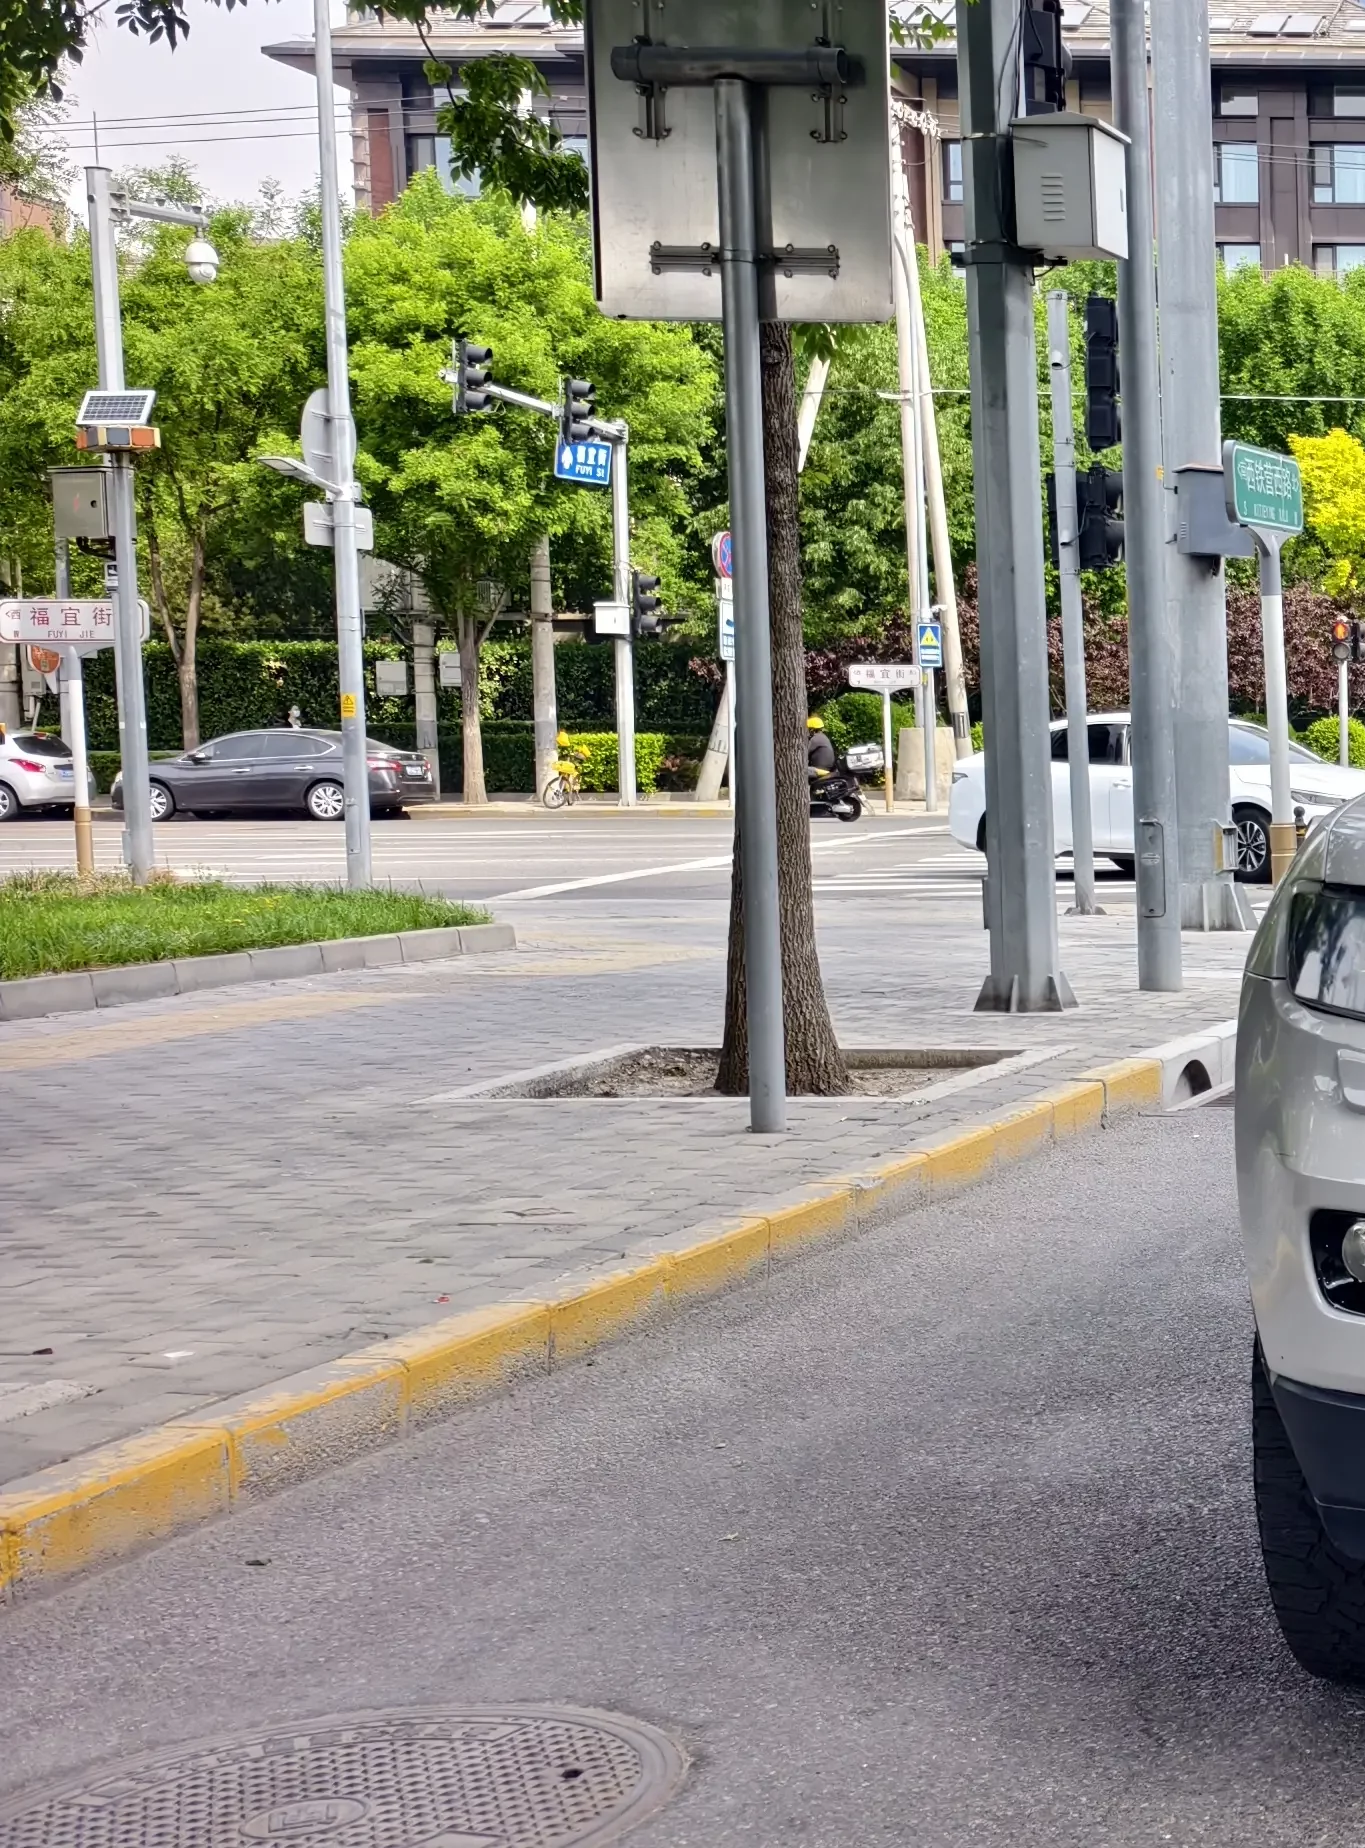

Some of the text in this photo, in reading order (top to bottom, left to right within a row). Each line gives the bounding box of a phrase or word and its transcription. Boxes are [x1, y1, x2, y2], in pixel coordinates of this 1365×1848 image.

[575, 464, 593, 476] FUYI
[30, 606, 112, 626] 福宜街
[47, 630, 68, 638] FUYI
[79, 630, 96, 638] JIE
